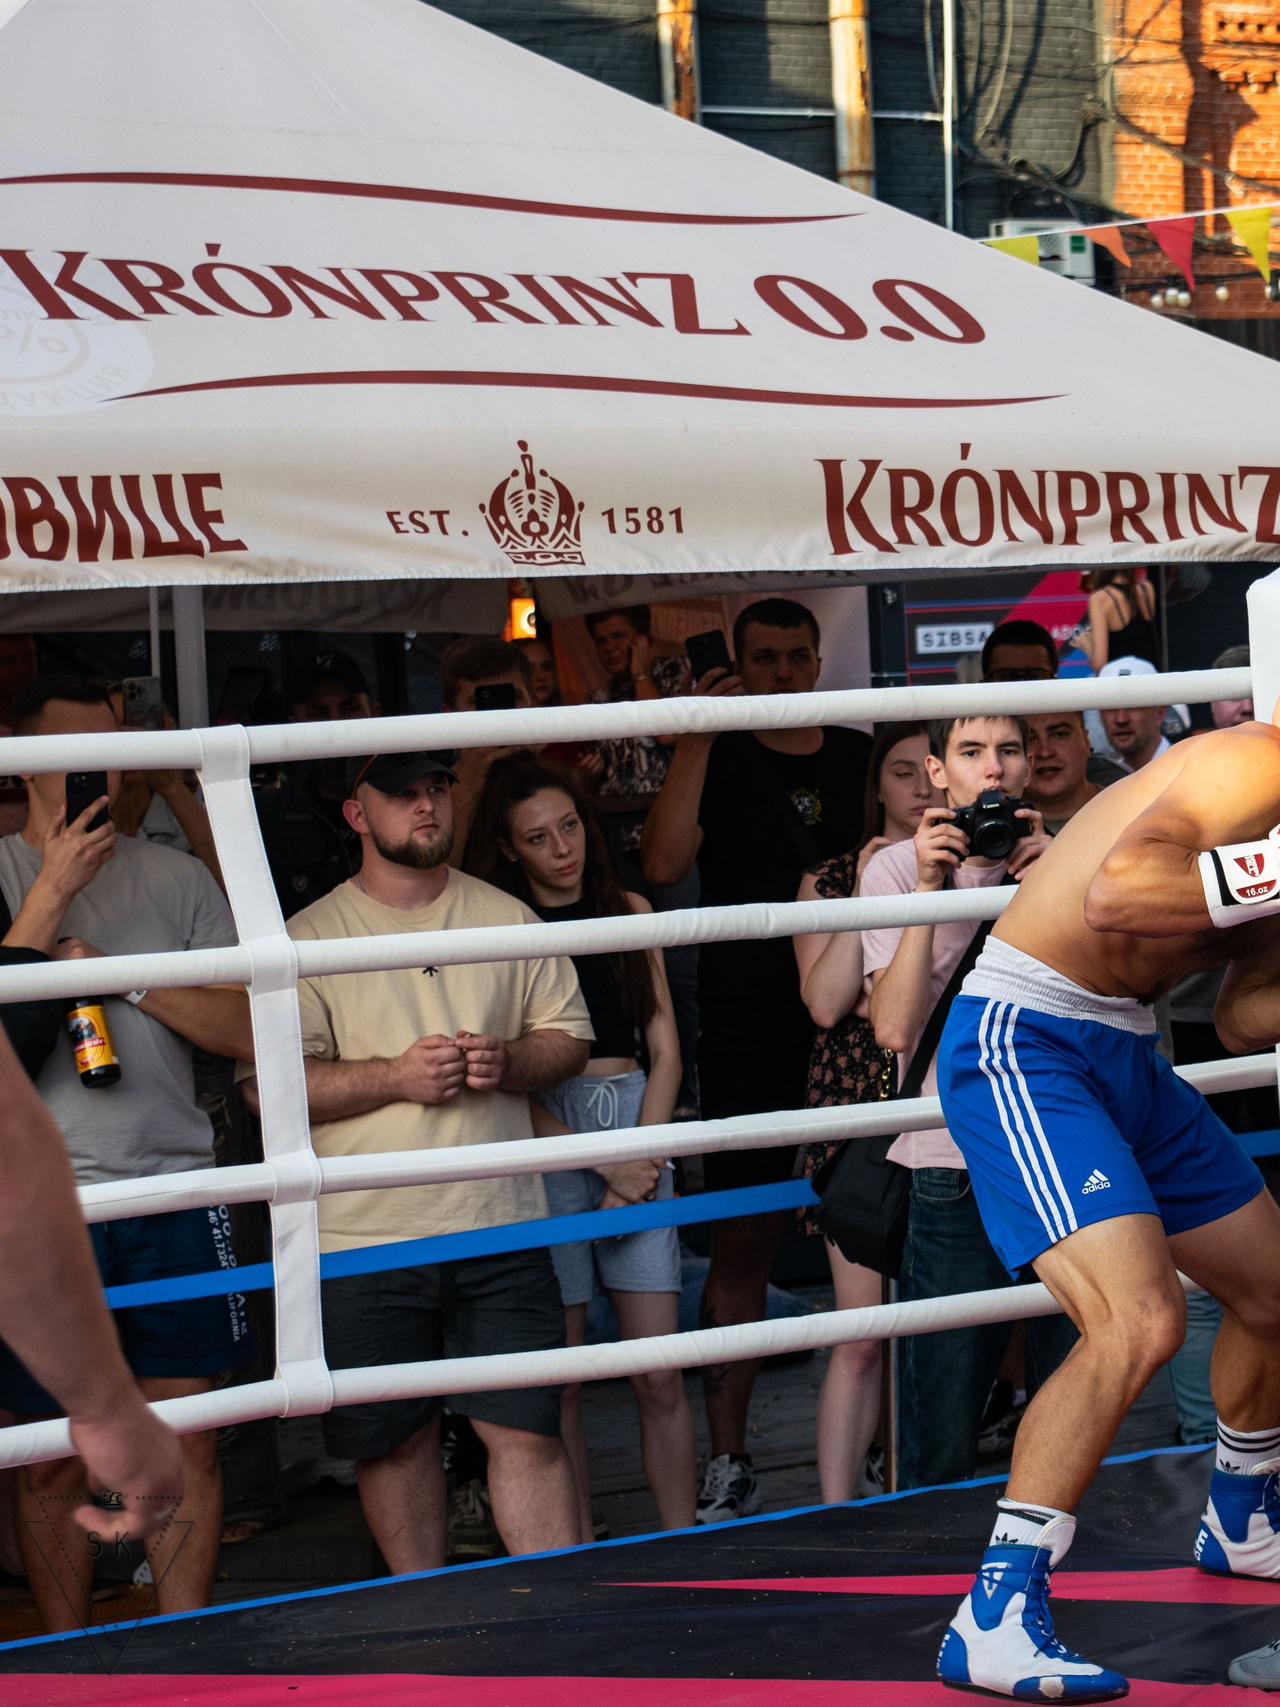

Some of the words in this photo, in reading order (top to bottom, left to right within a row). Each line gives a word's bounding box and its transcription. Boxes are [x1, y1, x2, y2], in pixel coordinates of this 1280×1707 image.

[0, 473, 249, 563] ВИЦЕ
[386, 510, 470, 538] EST.
[600, 506, 687, 536] 1581
